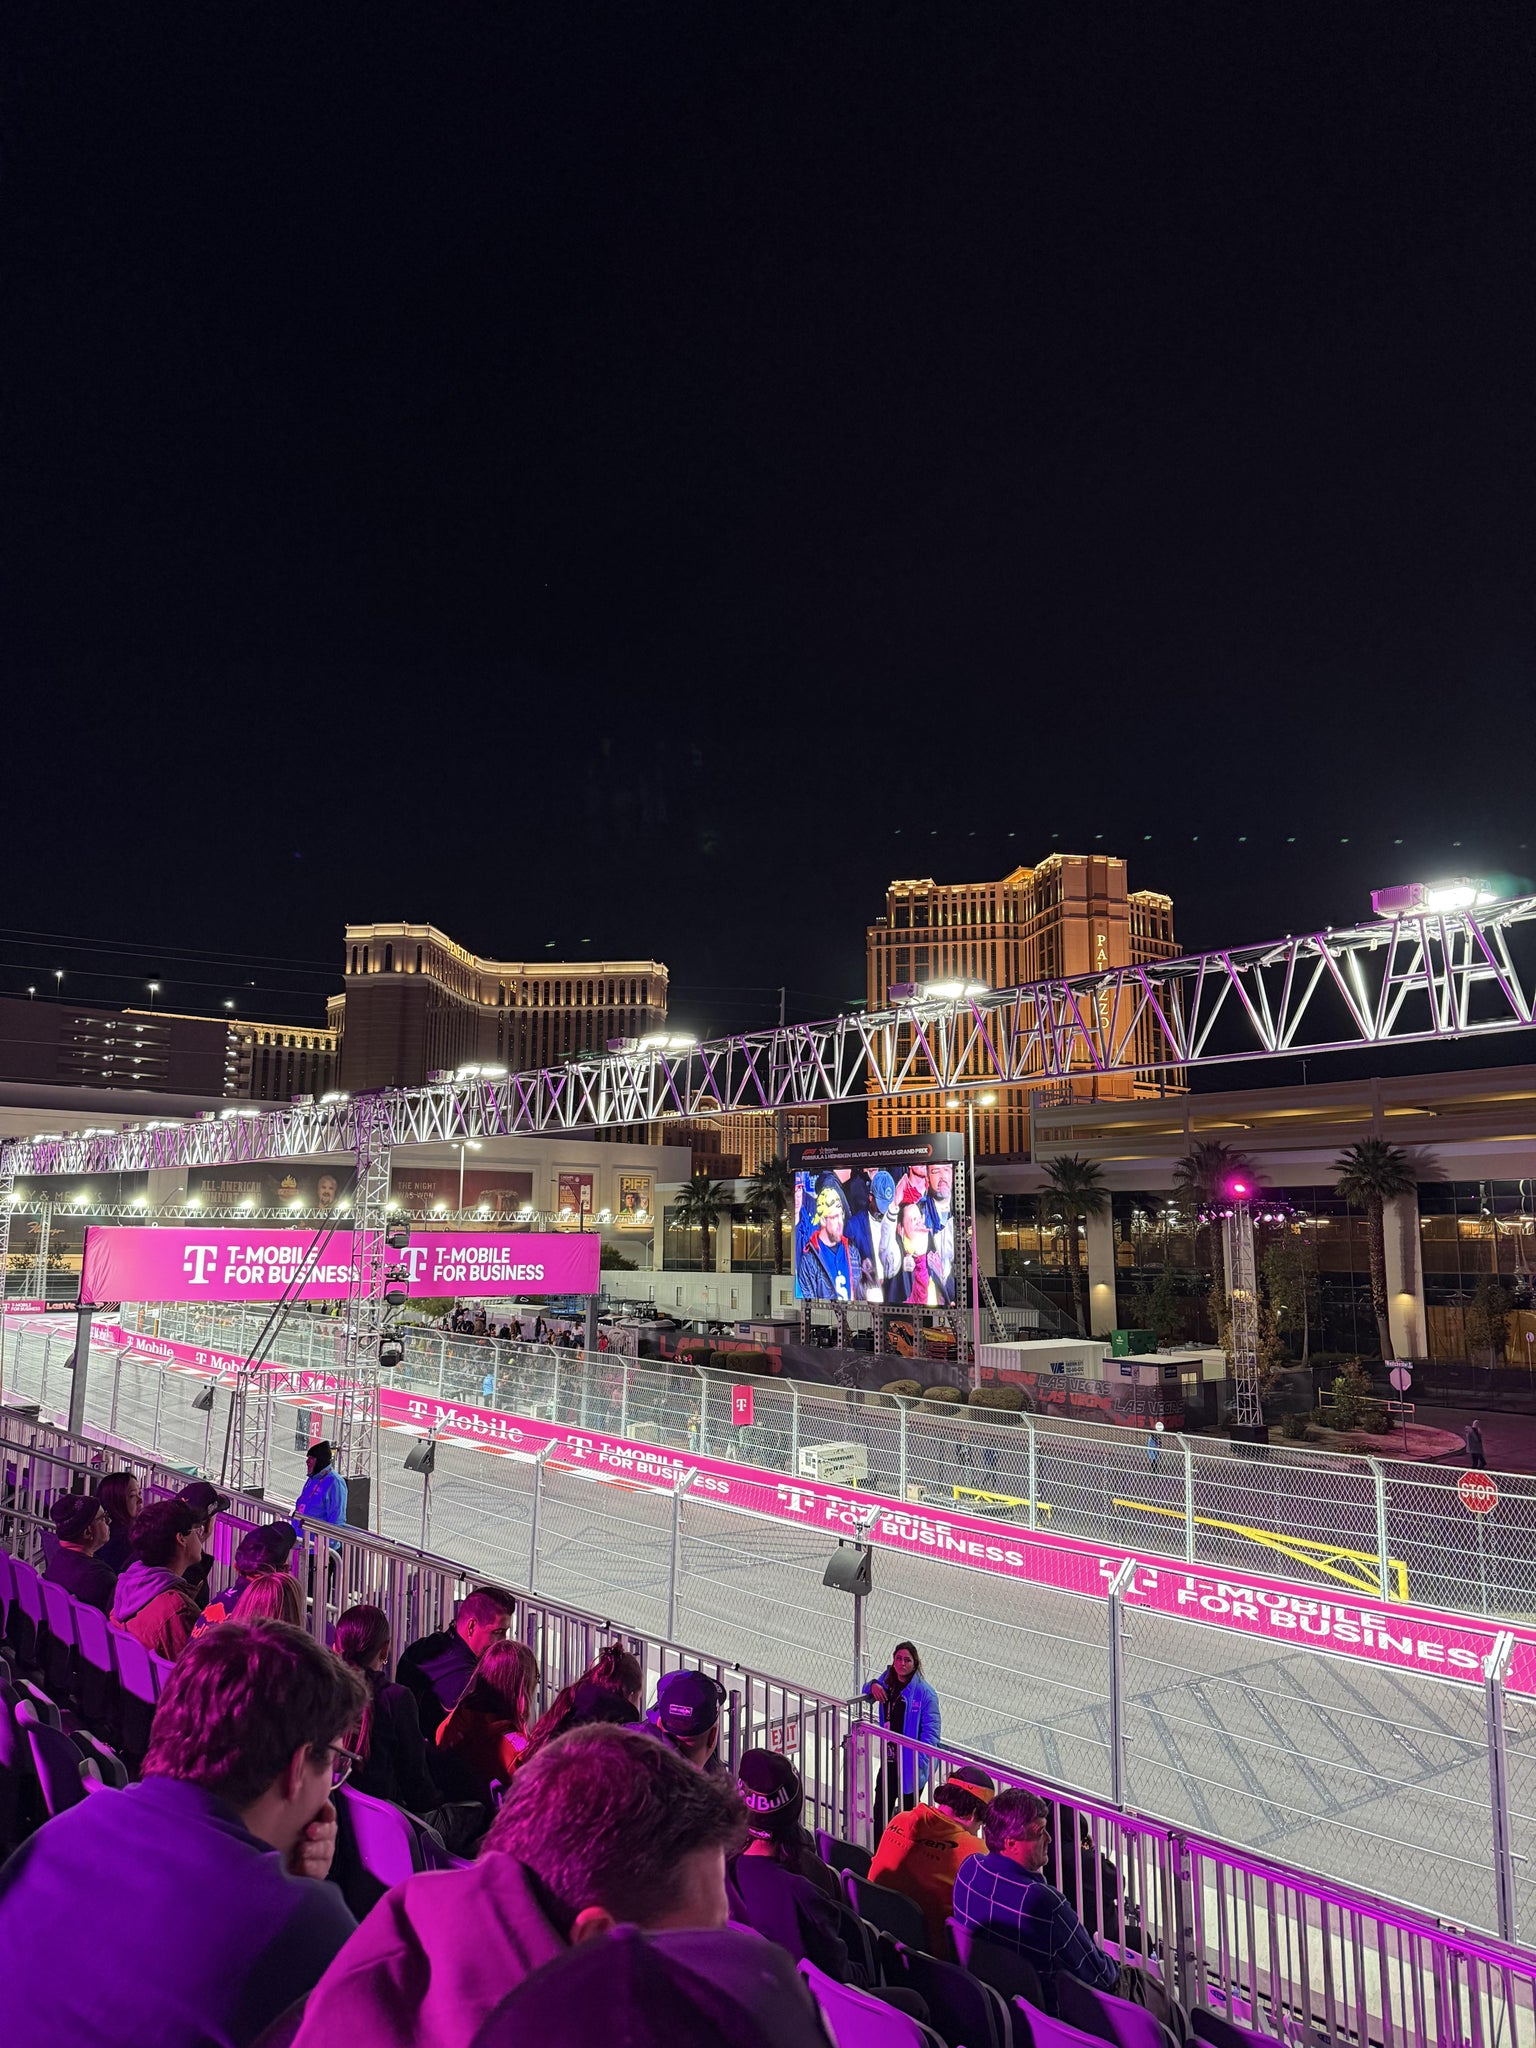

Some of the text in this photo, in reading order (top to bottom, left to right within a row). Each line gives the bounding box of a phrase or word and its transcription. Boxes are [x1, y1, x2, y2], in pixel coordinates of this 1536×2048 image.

[1096, 934, 1110, 1028] PALZZO
[414, 1182, 437, 1191] NIGHT
[623, 1178, 649, 1191] PIFF
[227, 1246, 319, 1265] T-MOBILE
[435, 1247, 511, 1264] T-MOBILE
[224, 1265, 361, 1284] FOR BUSINESS
[433, 1264, 545, 1282] FOR BUSINESS
[136, 1339, 175, 1357] Mobile
[1038, 1375, 1112, 1396] LAS VEGAS
[1039, 1388, 1067, 1403] LAS
[1114, 1397, 1186, 1415] LAS VEGAS
[434, 1406, 524, 1443] Mobile
[598, 1453, 633, 1470] FOR
[600, 1442, 684, 1467] T-MOBILE
[1461, 1483, 1495, 1501] STOP
[882, 1520, 1024, 1567] BUSINESS
[1185, 1576, 1387, 1632] T-MOBILE
[1177, 1588, 1514, 1677] FOR BUSINES
